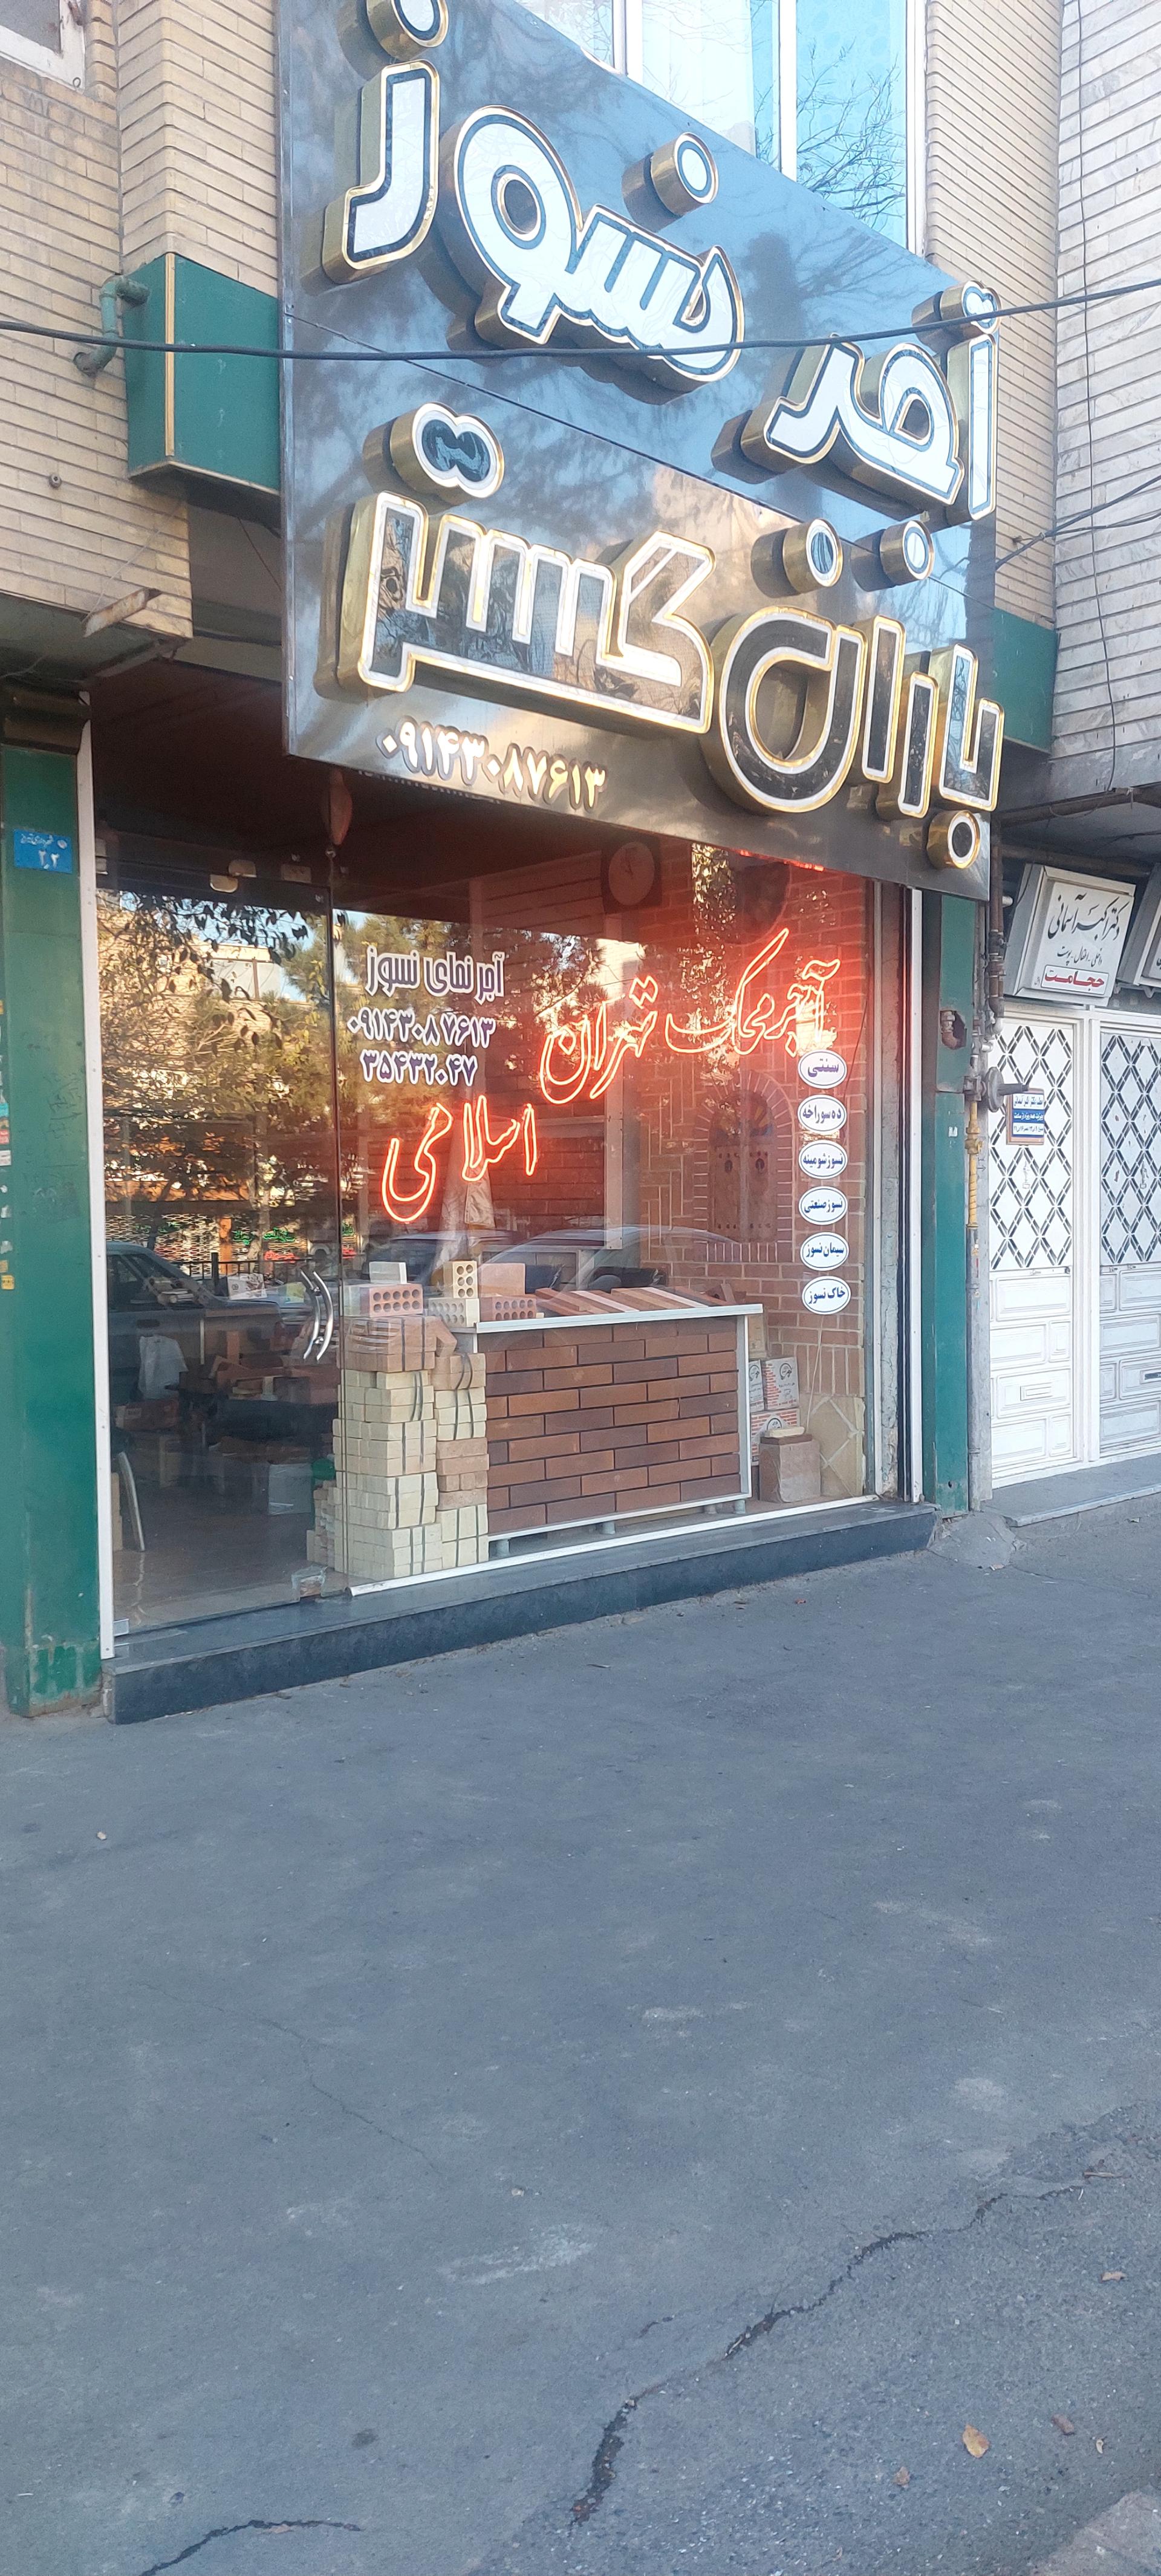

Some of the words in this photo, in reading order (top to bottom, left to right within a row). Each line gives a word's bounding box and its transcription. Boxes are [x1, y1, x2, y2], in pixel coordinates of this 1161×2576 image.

[330, 0, 747, 385] نسوز
[756, 279, 1001, 582] آجر
[357, 402, 717, 735] گستر
[718, 517, 1006, 871] باران
[376, 716, 607, 813] ۰۹۱۴۳۰۸۷۶۱۳
[1047, 893, 1087, 940] آسمانی
[365, 945, 420, 997] نسوز
[423, 951, 474, 997] نمای
[475, 951, 506, 1005] آجر
[1044, 969, 1105, 992] حجامت
[763, 958, 841, 1058] آجر
[539, 975, 659, 1105] تهران
[360, 1049, 478, 1087] ۳۵۴۳۲۰۴۷
[807, 1058, 839, 1078] سنتی
[381, 1095, 538, 1223] اسلامی
[827, 1153, 844, 1169] نسوز
[804, 1199, 827, 1214] صنعتی
[827, 1198, 843, 1213] نسوز
[805, 1242, 823, 1258] نسوز
[823, 1241, 845, 1258] سیمان
[808, 1287, 827, 1304] نسوز
[827, 1286, 846, 1299] خاک
